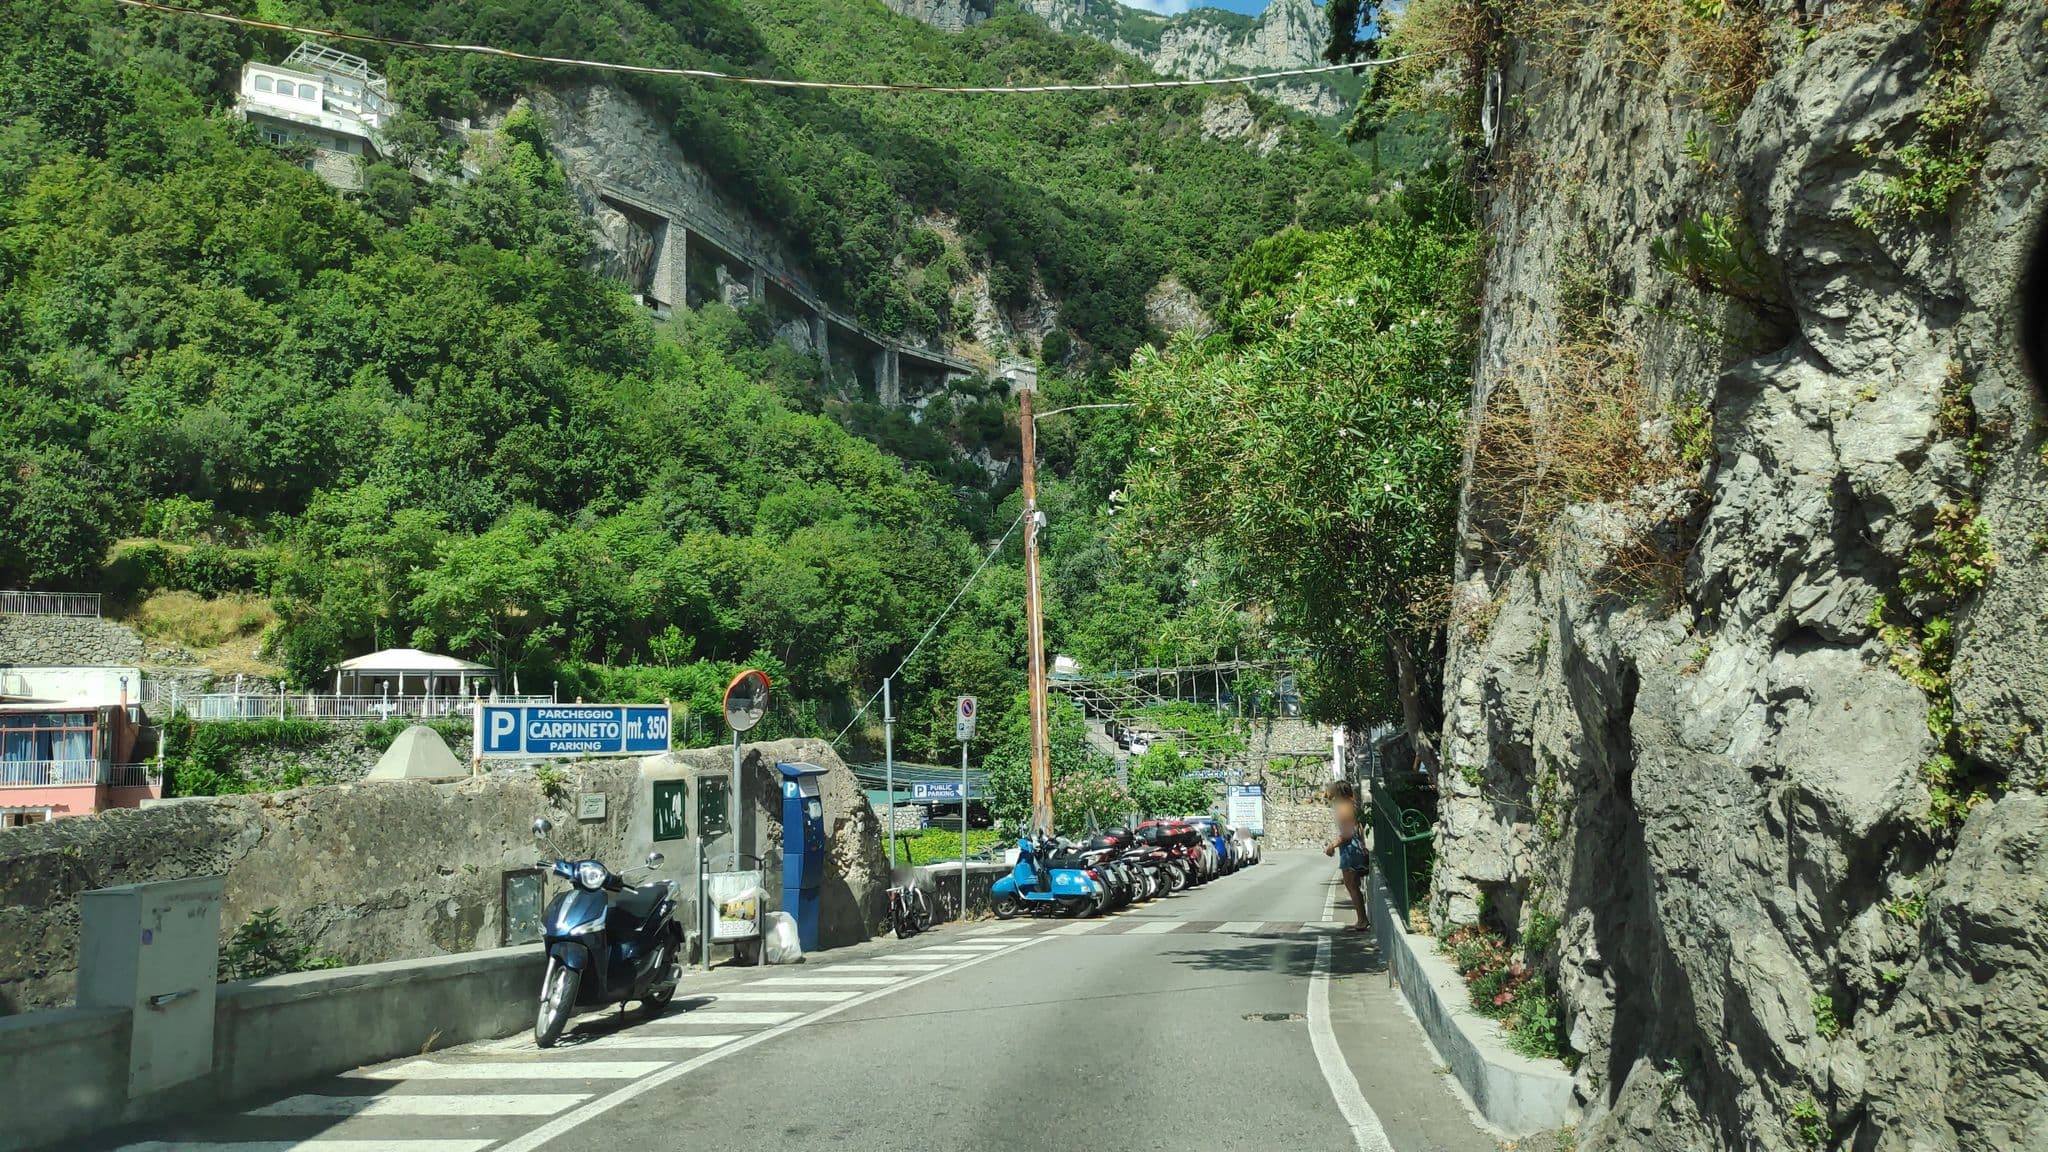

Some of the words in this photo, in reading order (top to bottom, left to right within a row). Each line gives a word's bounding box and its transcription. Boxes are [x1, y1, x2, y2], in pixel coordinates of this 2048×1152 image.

[537, 709, 614, 719] PARCHEGGIO
[490, 711, 515, 748] P
[529, 721, 619, 739] CARPINETO
[627, 716, 644, 739] mt.
[646, 715, 667, 740] 350
[550, 741, 601, 751] PARKING
[787, 781, 796, 798] P
